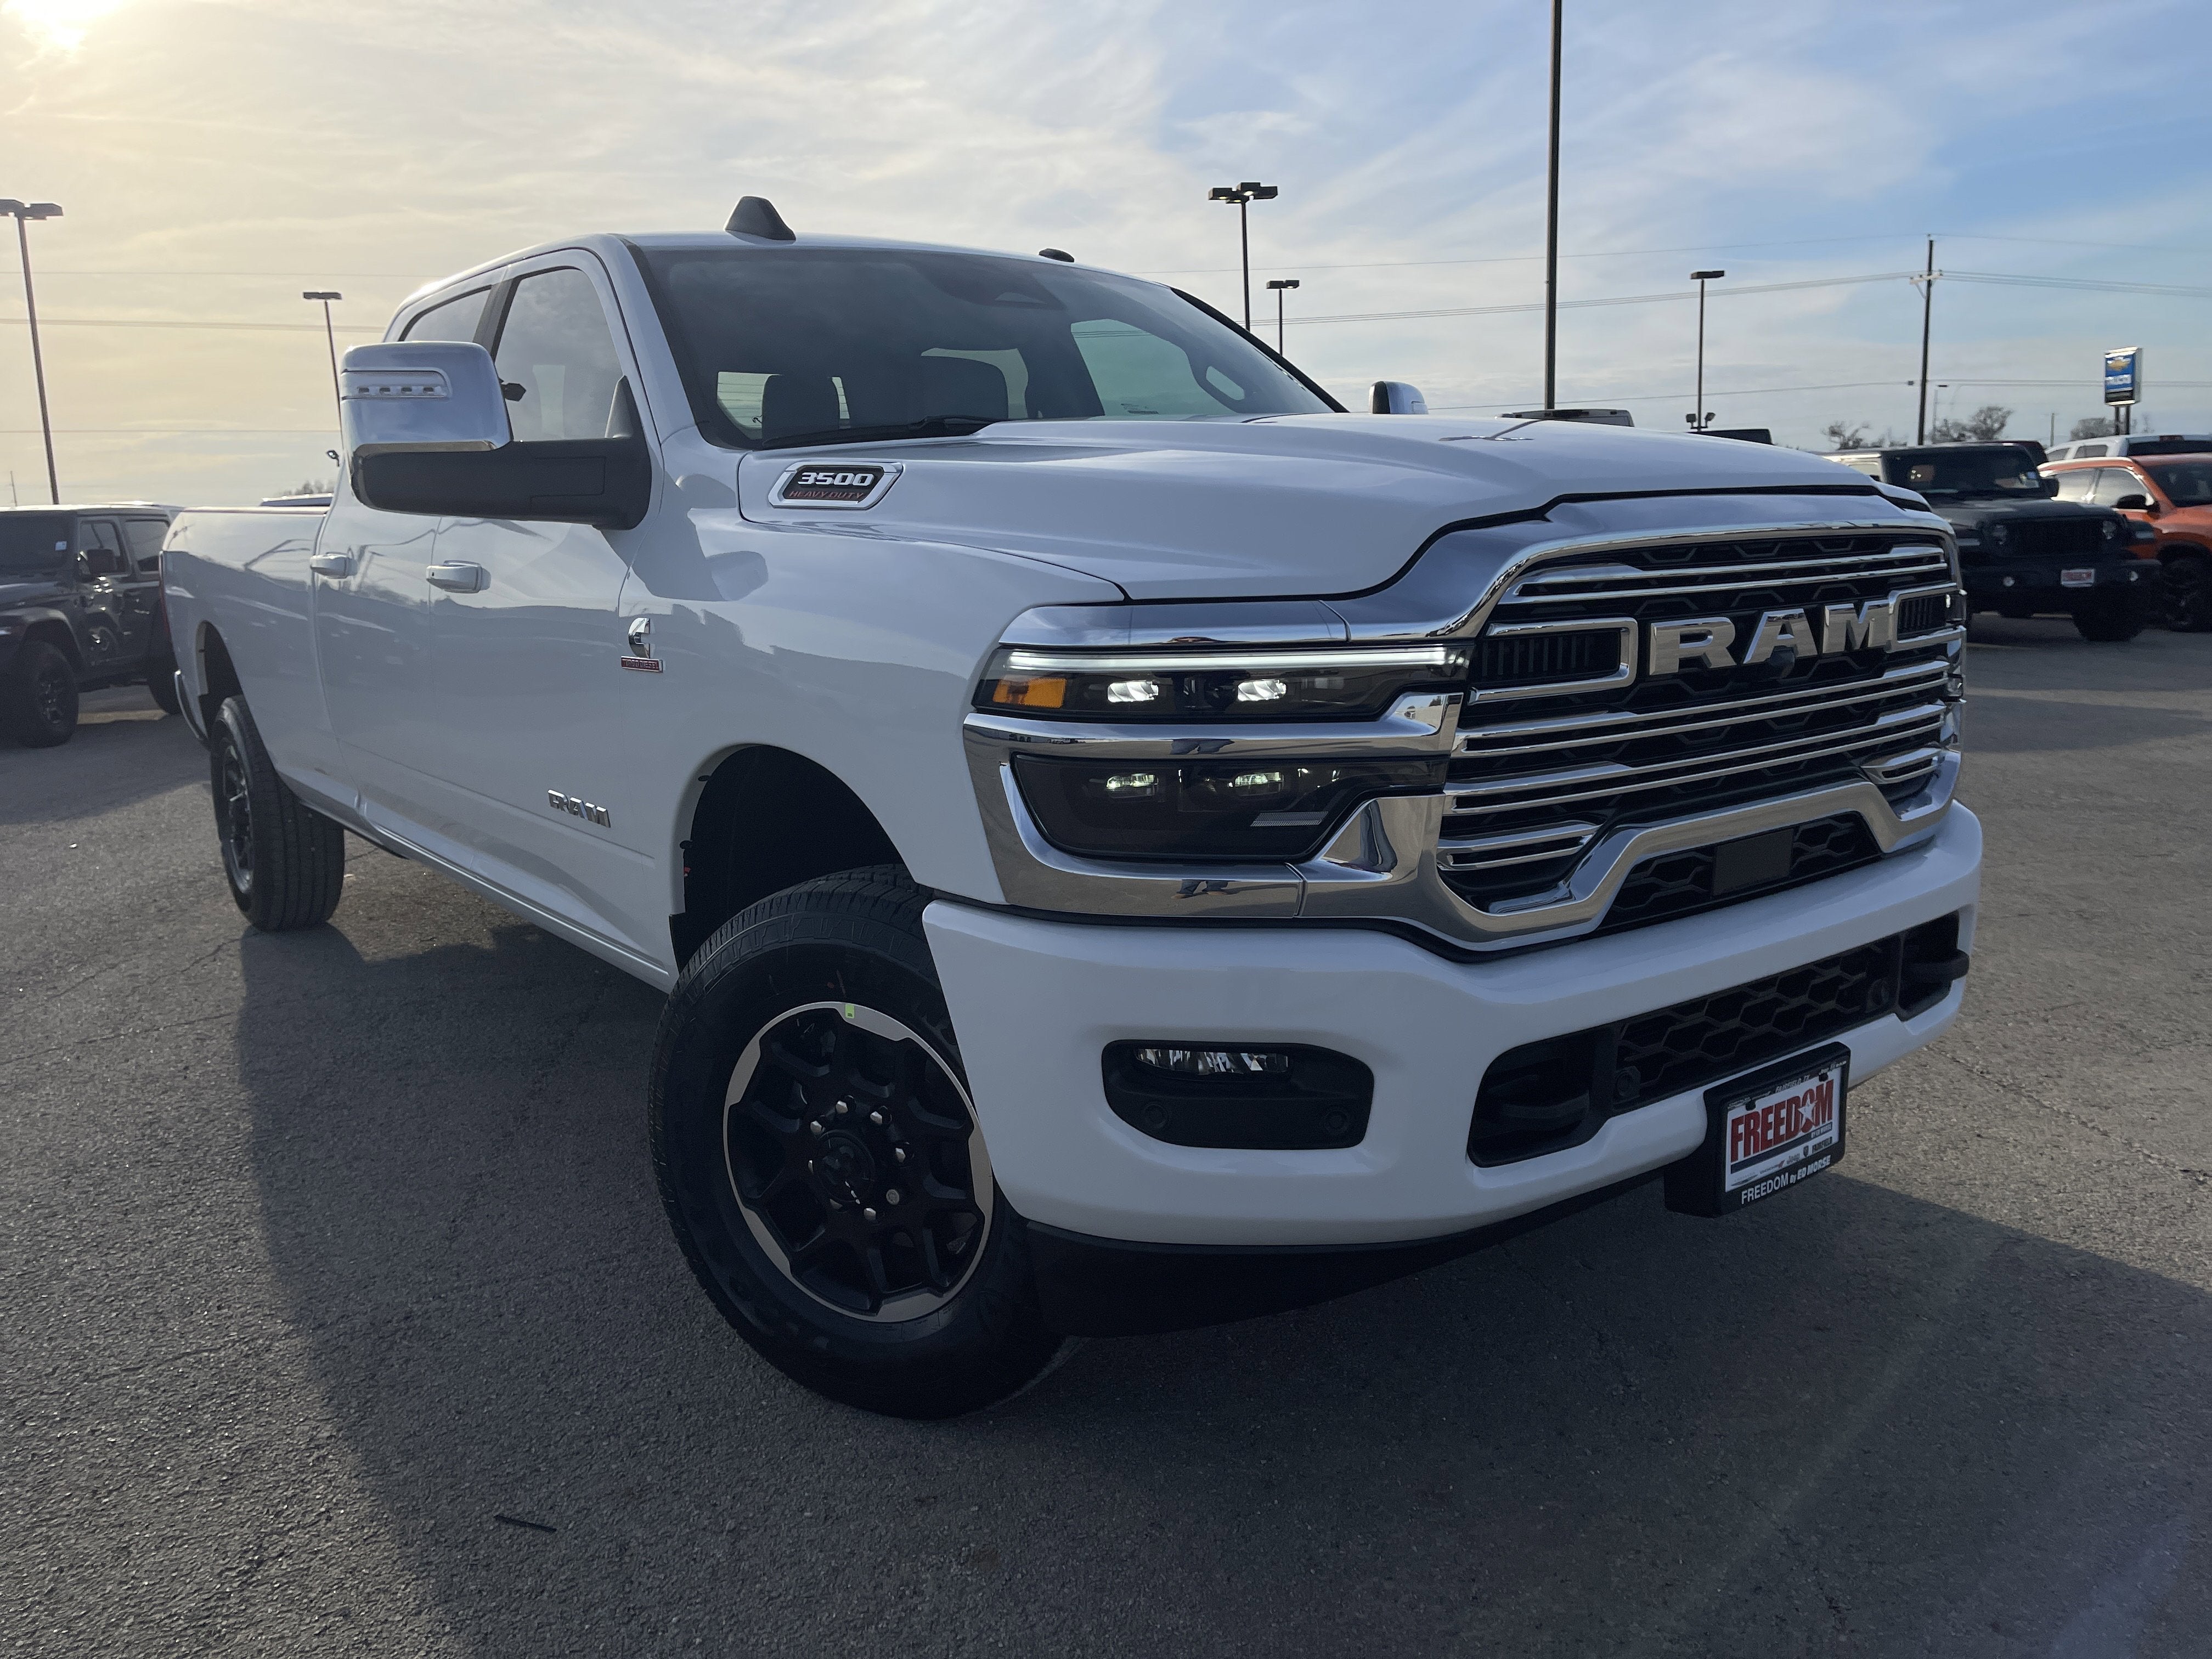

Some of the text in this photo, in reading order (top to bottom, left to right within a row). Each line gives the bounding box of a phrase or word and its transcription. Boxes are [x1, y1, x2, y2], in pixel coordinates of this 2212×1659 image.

[797, 472, 875, 487] 3500
[1649, 599, 1892, 675] RAM
[548, 789, 611, 828] RAM
[1730, 1079, 1834, 1163] FREEDOM
[1741, 1172, 1789, 1205] FREEDOM
[1797, 1167, 1807, 1180] ED
[1807, 1155, 1831, 1176] MORSE
